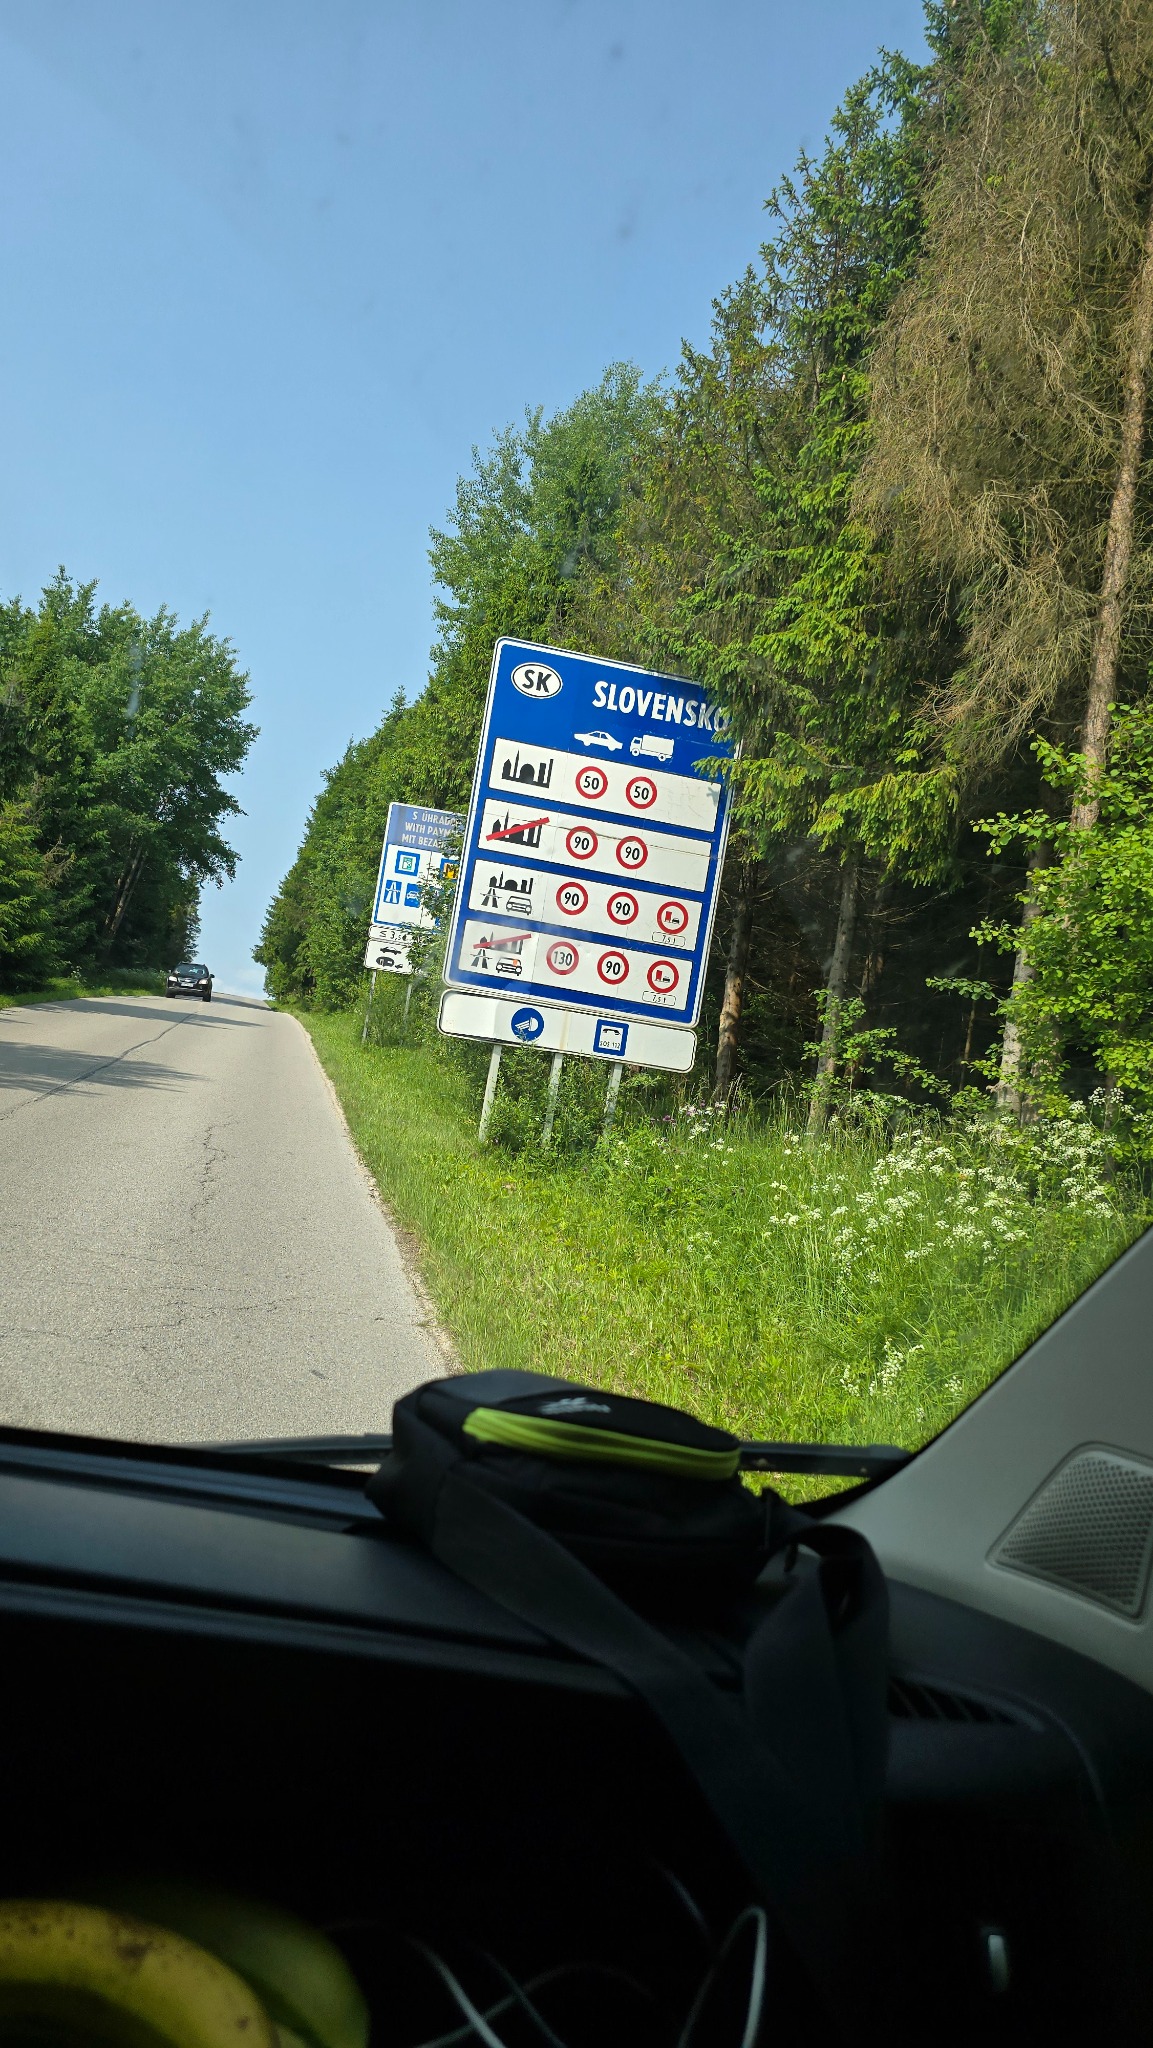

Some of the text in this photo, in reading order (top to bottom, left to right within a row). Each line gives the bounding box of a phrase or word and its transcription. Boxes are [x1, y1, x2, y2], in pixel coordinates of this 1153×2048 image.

[522, 670, 550, 693] SK
[592, 681, 730, 733] SLOVENSKO
[583, 776, 650, 800] 50 50
[412, 811, 418, 820] S
[401, 833, 417, 844] MIT
[405, 822, 426, 834] WITH
[574, 836, 640, 861] 90 90
[564, 891, 631, 916] 90 90
[552, 950, 621, 975] 130 90
